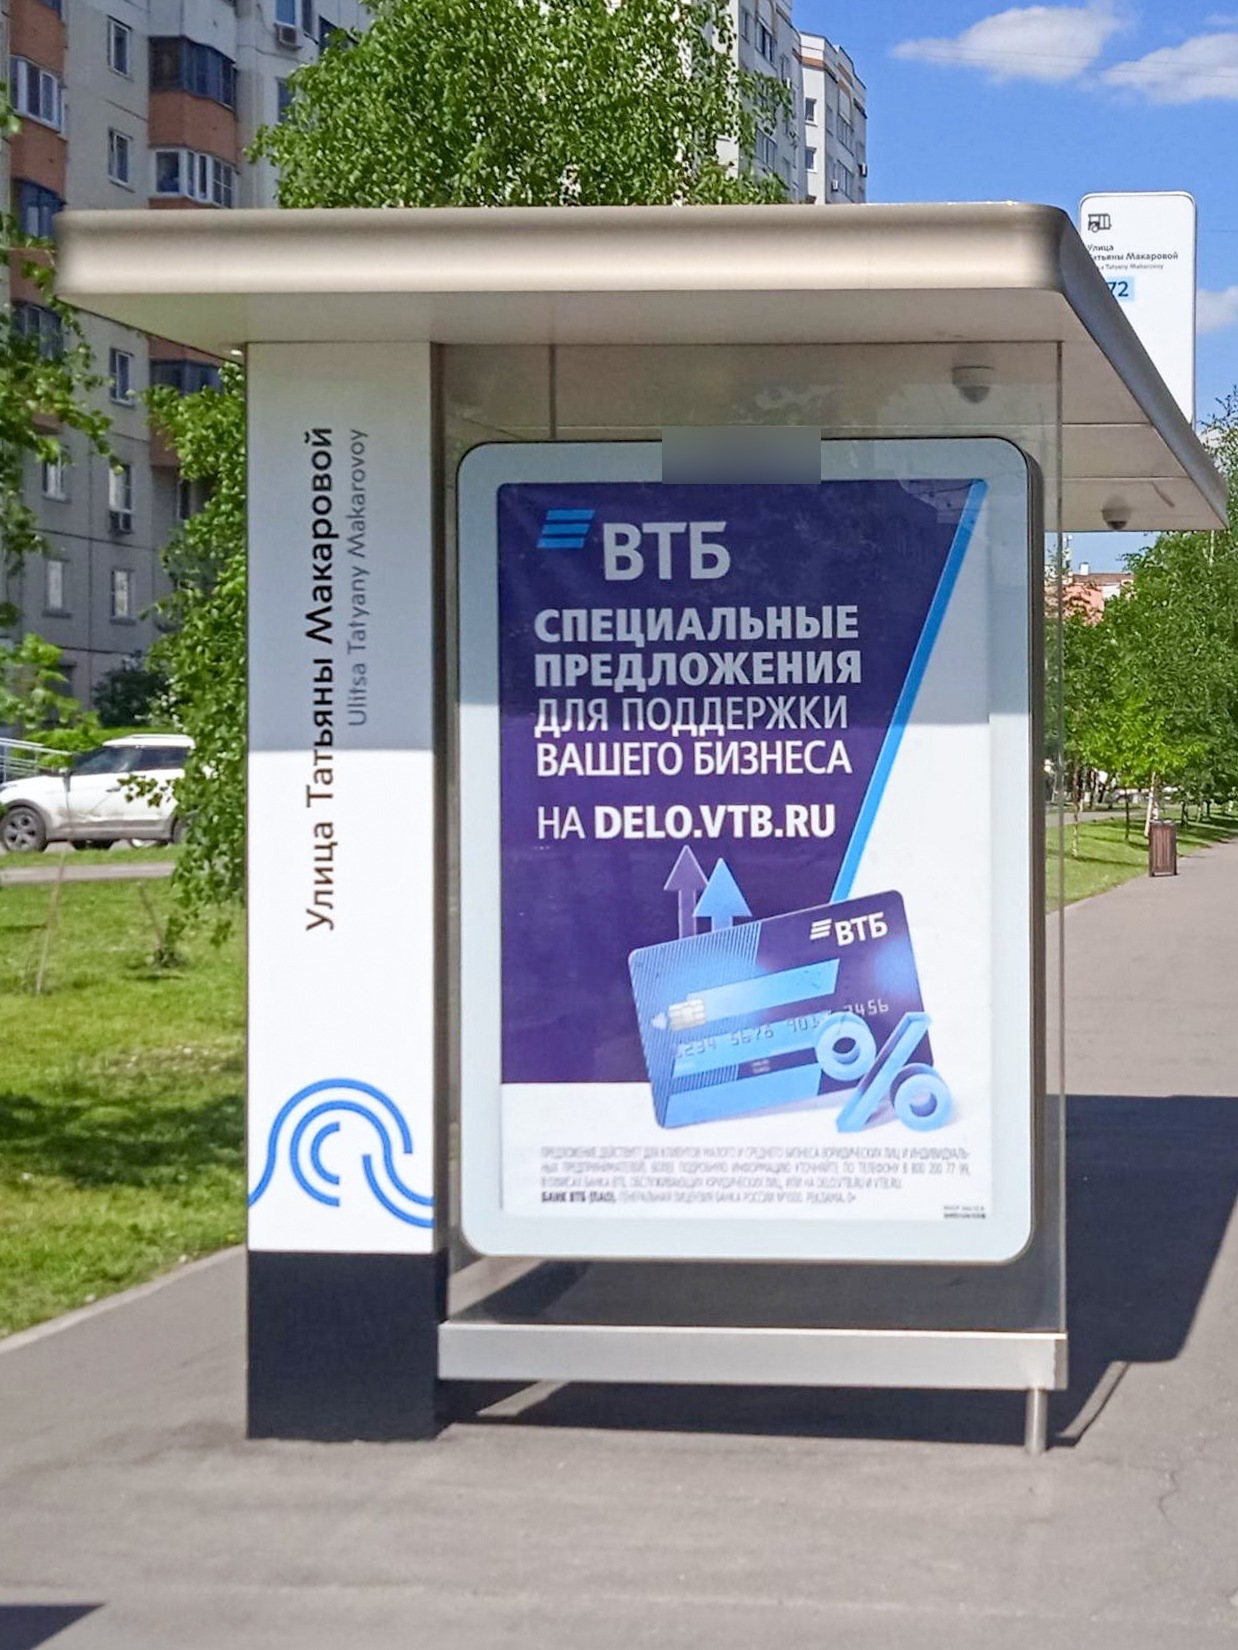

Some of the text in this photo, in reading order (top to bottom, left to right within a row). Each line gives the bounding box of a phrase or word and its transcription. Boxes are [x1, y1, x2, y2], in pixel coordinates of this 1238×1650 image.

[1126, 251, 1178, 261] Макаровой
[602, 521, 731, 580] ВТБ
[347, 428, 371, 726] Ulitsa Tatyany Makarovoy
[534, 605, 860, 648] СПЕЦИАЛЬНЫЕ
[305, 427, 339, 931] Улица Татьяны Макаровой
[535, 651, 862, 692] ПРЕДЛОЖЕНИЯ
[534, 695, 848, 738] ДЛЯ ПОДДЕРЖКИ
[537, 740, 852, 777] ВАШЕГО БИЗНЕСА
[538, 803, 836, 840] НА DELO.VTB.RU
[834, 912, 888, 946] ВТБ
